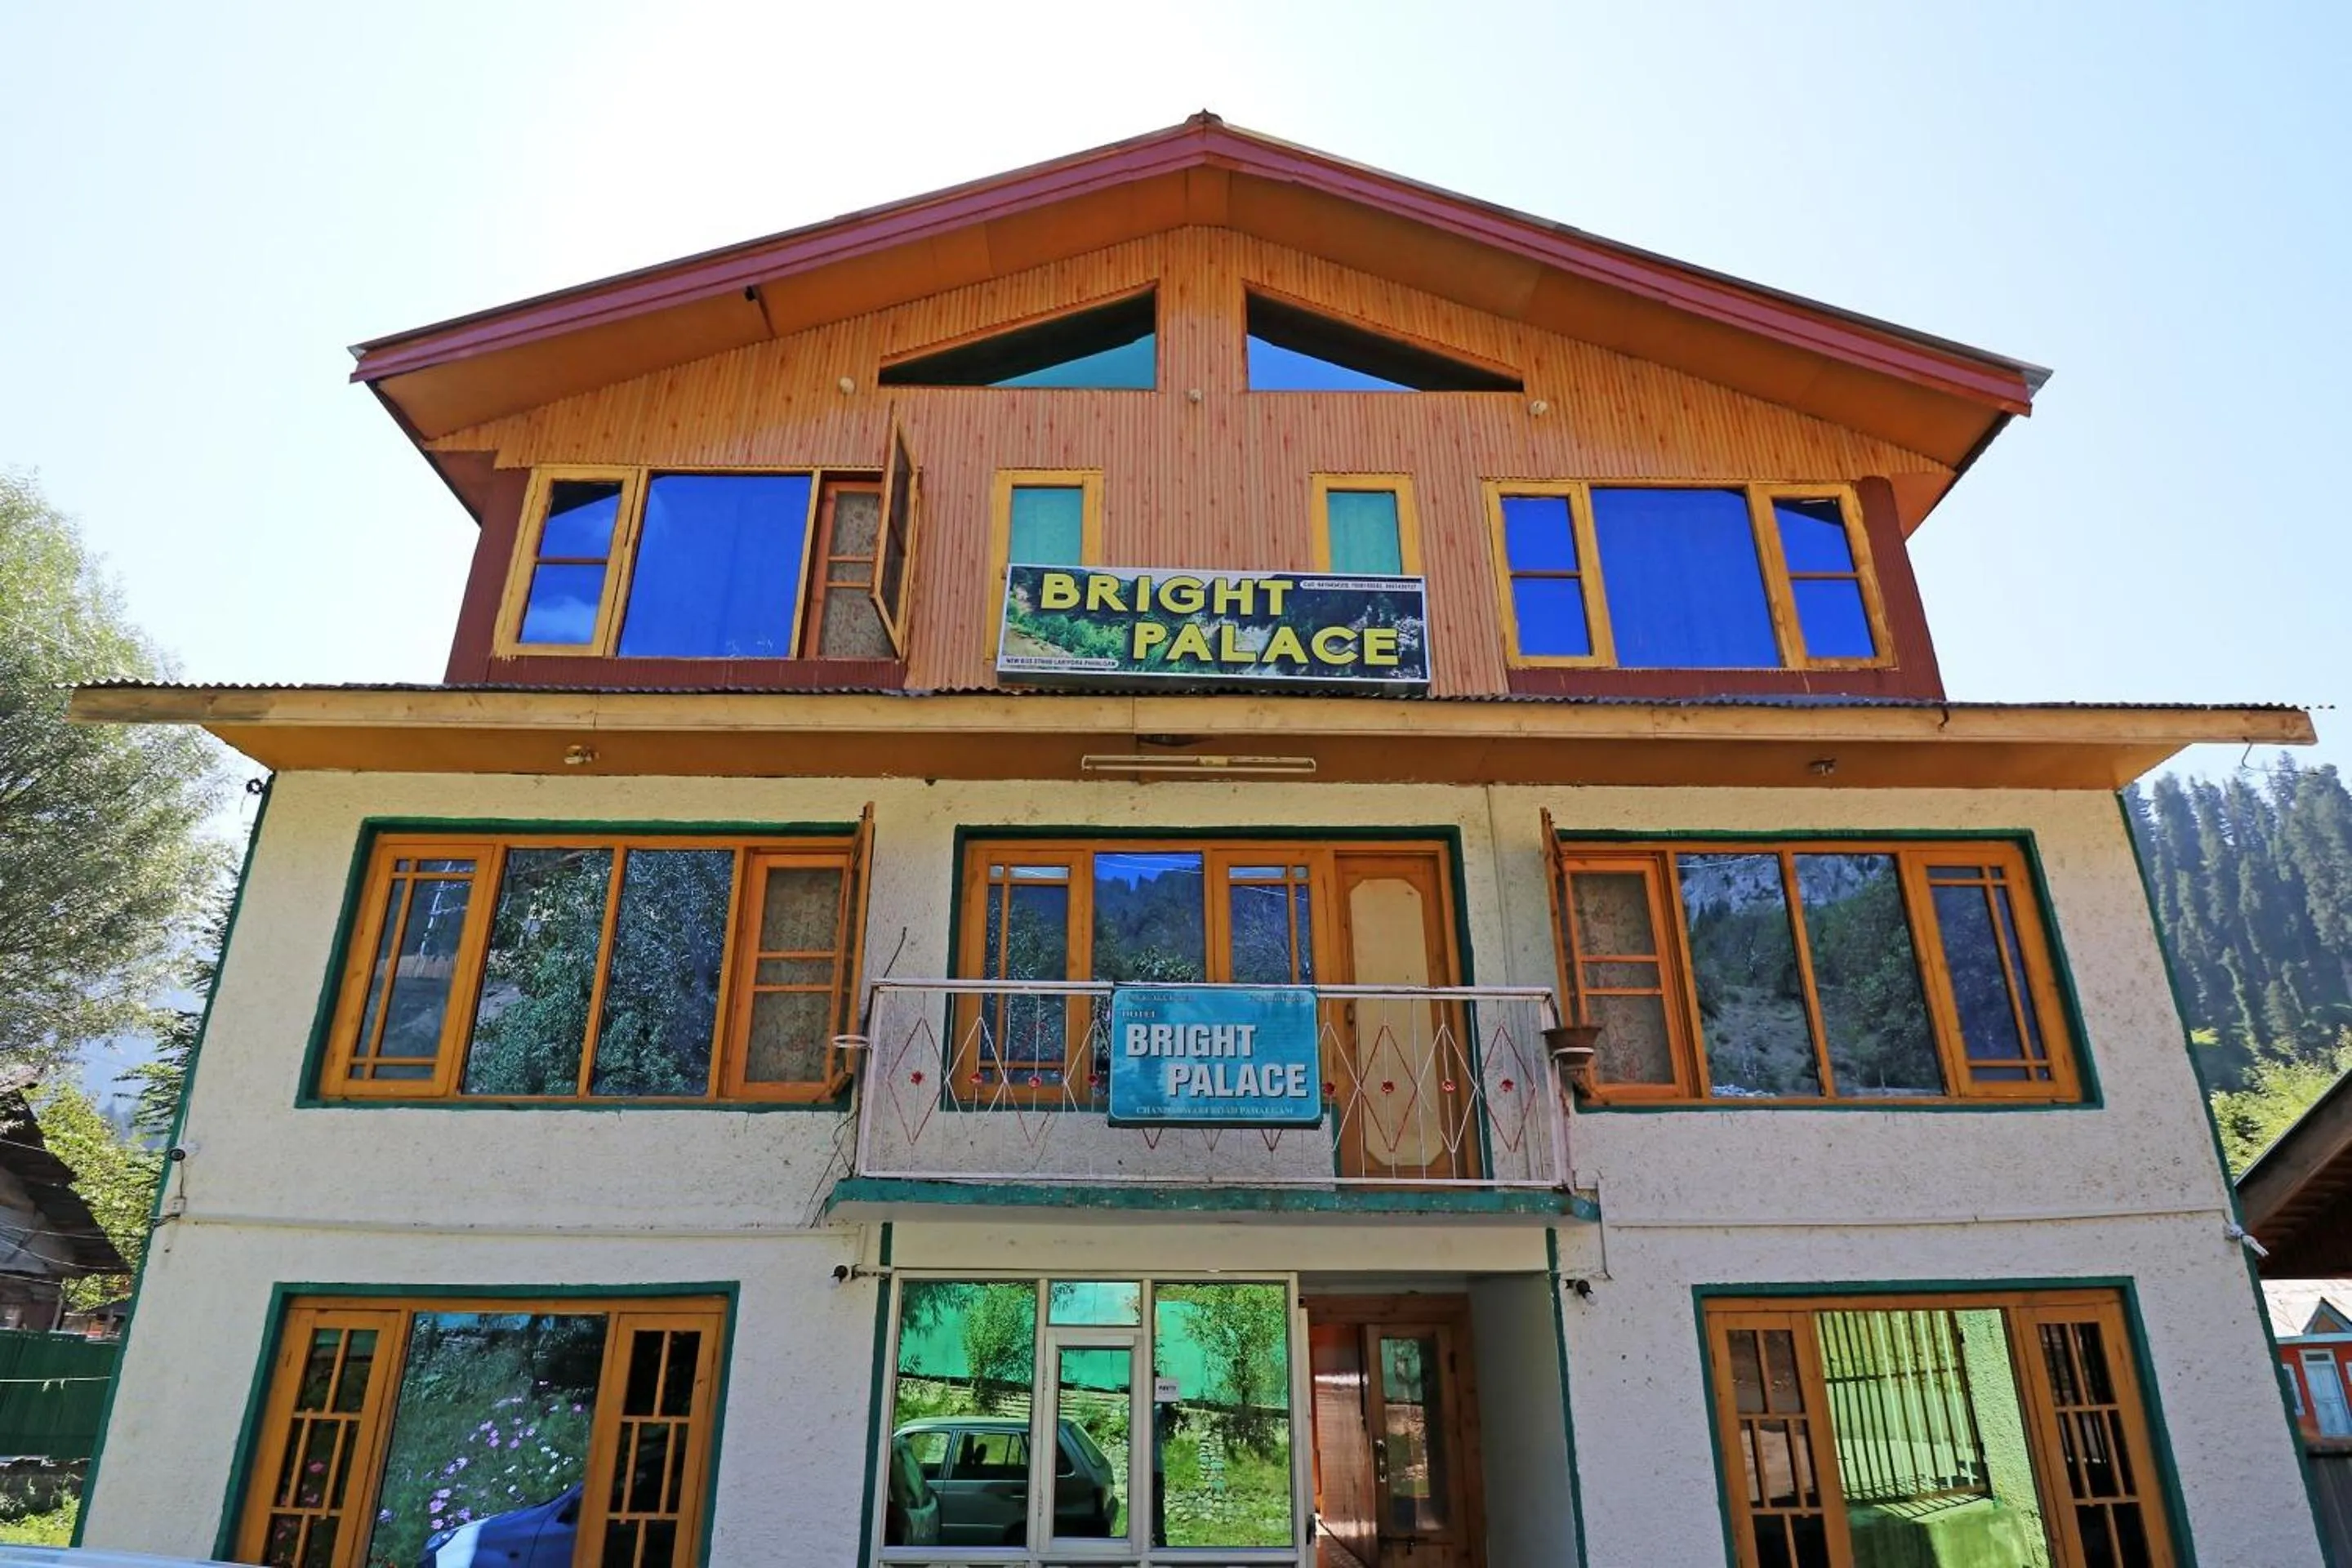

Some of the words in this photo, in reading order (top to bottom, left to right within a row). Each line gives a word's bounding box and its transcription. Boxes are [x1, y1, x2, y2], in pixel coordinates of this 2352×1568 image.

[1040, 573, 1293, 616] BRIGHT
[1134, 622, 1398, 665] PALACE
[1126, 1024, 1256, 1057] BRIGHT
[1168, 1063, 1308, 1097] PALACE
